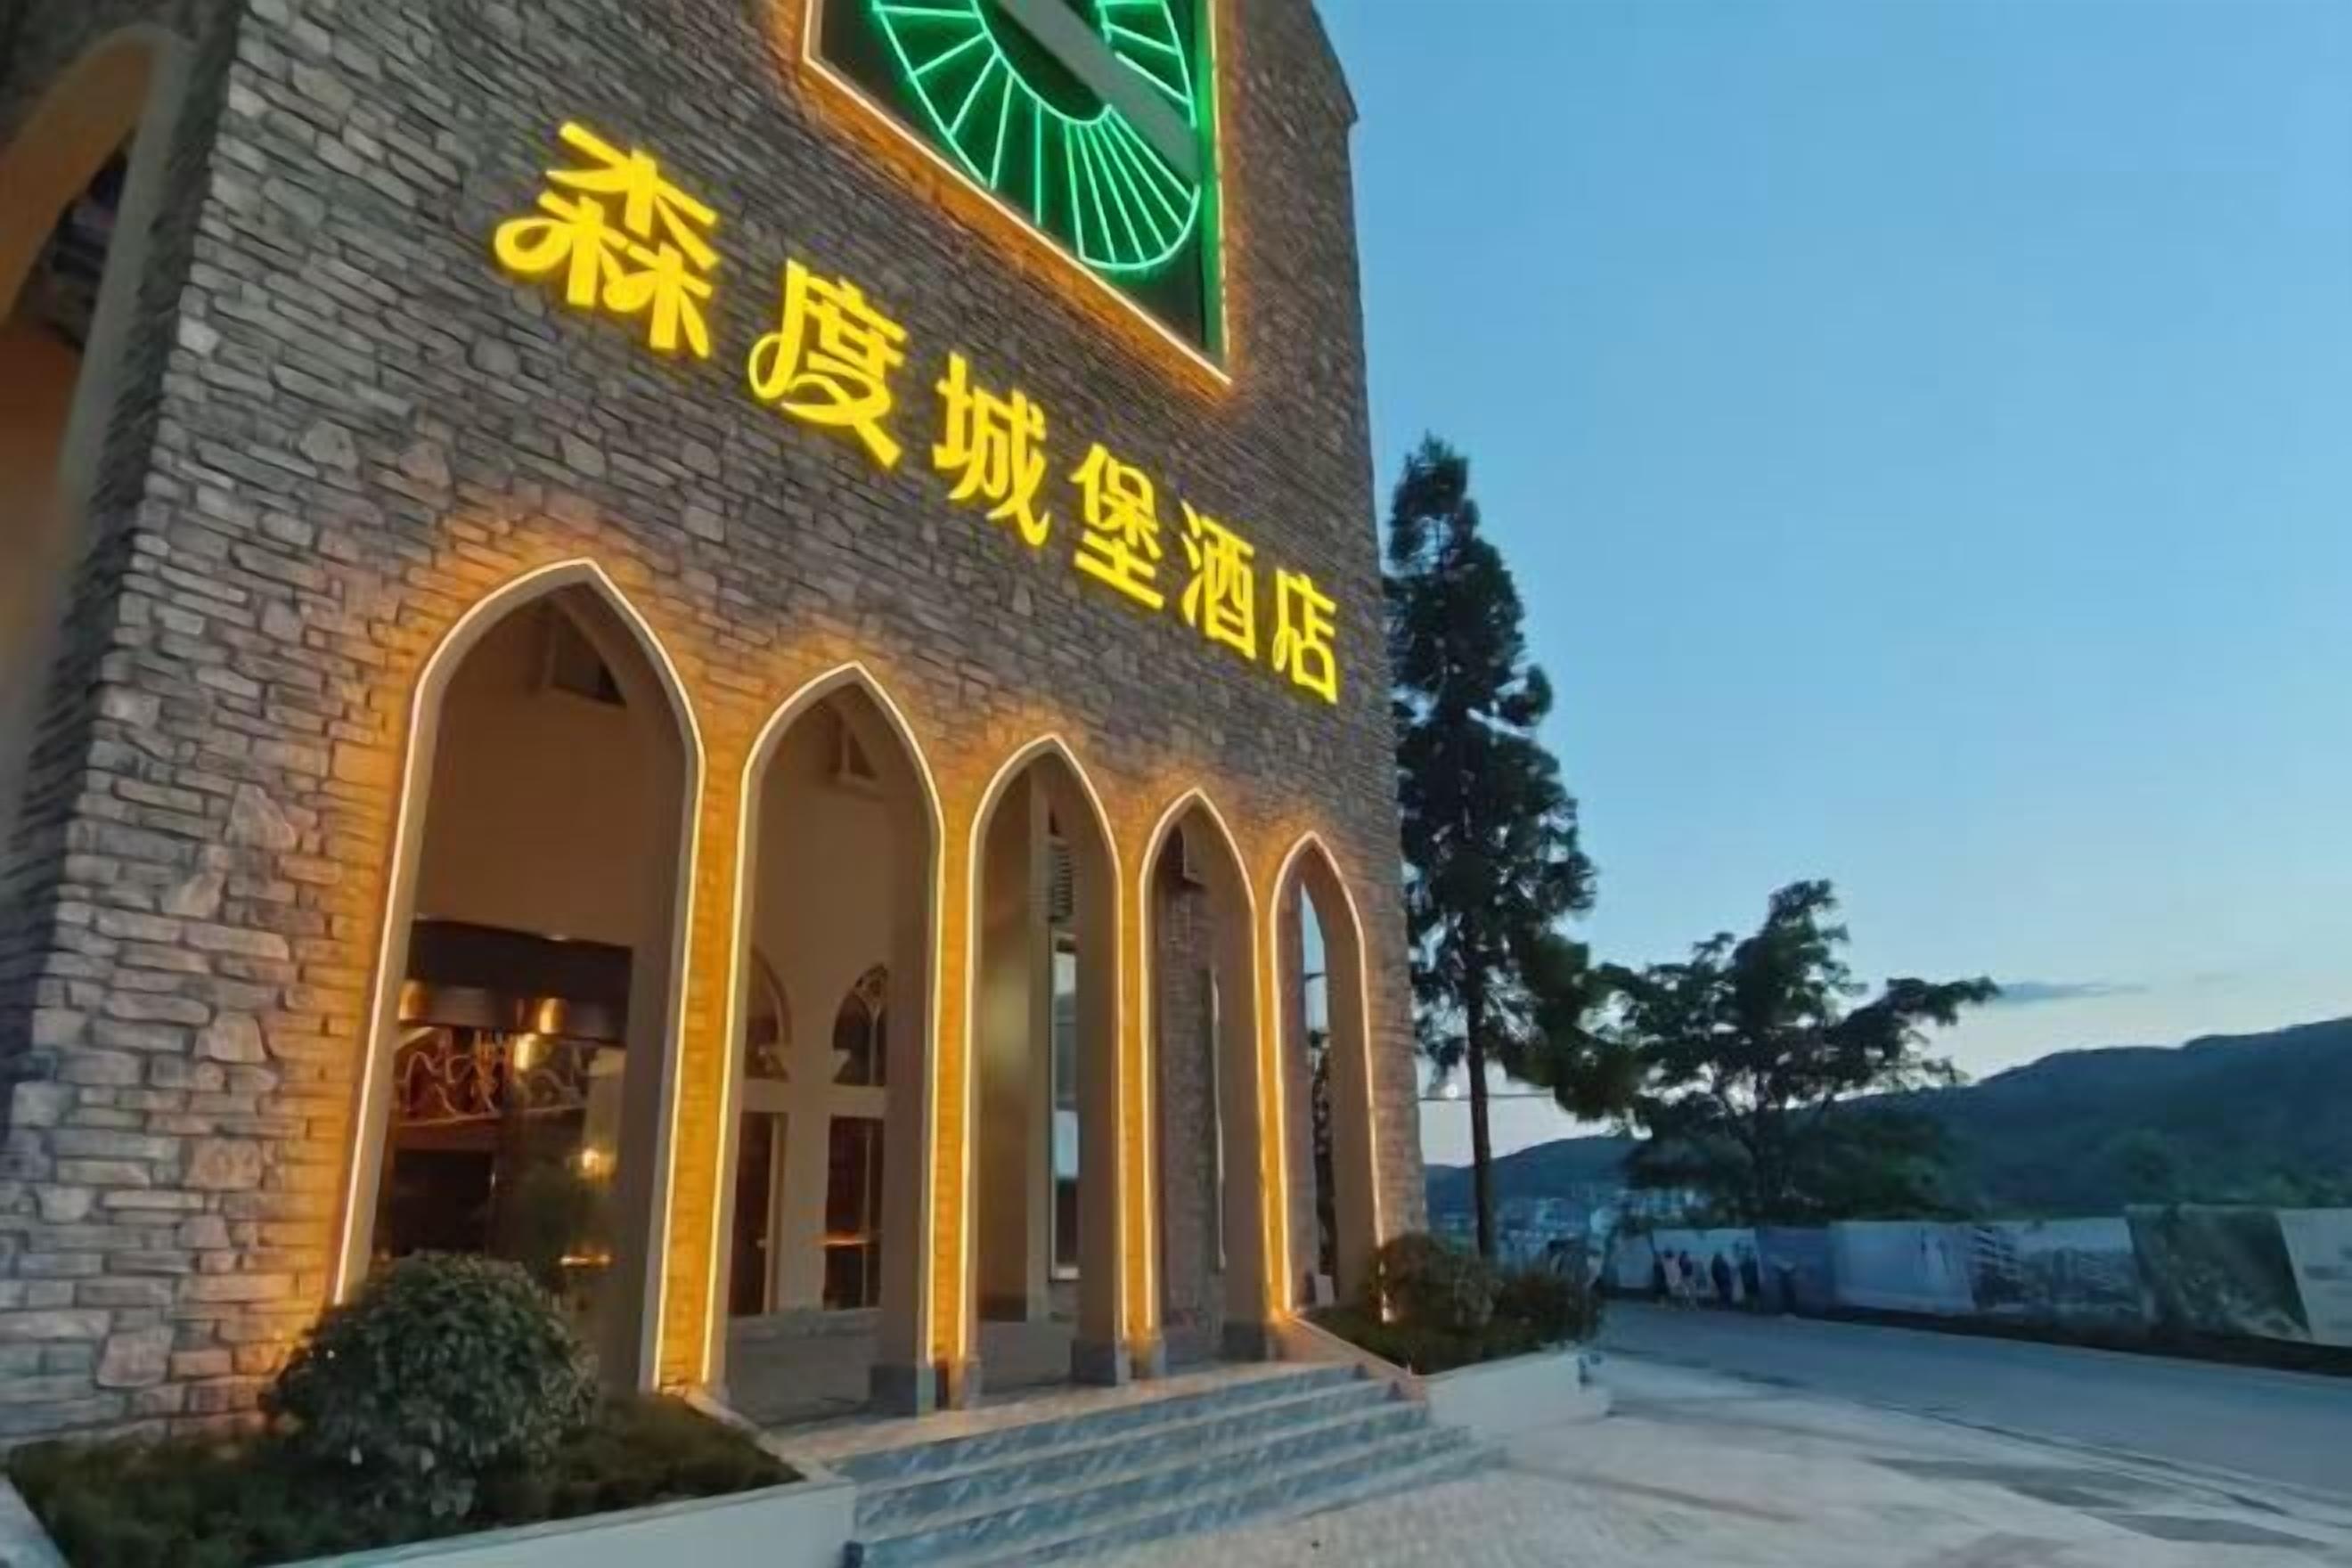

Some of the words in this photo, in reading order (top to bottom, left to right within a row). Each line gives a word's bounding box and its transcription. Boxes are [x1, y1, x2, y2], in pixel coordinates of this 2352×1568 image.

[494, 120, 1339, 704] 森度城堡酒店
